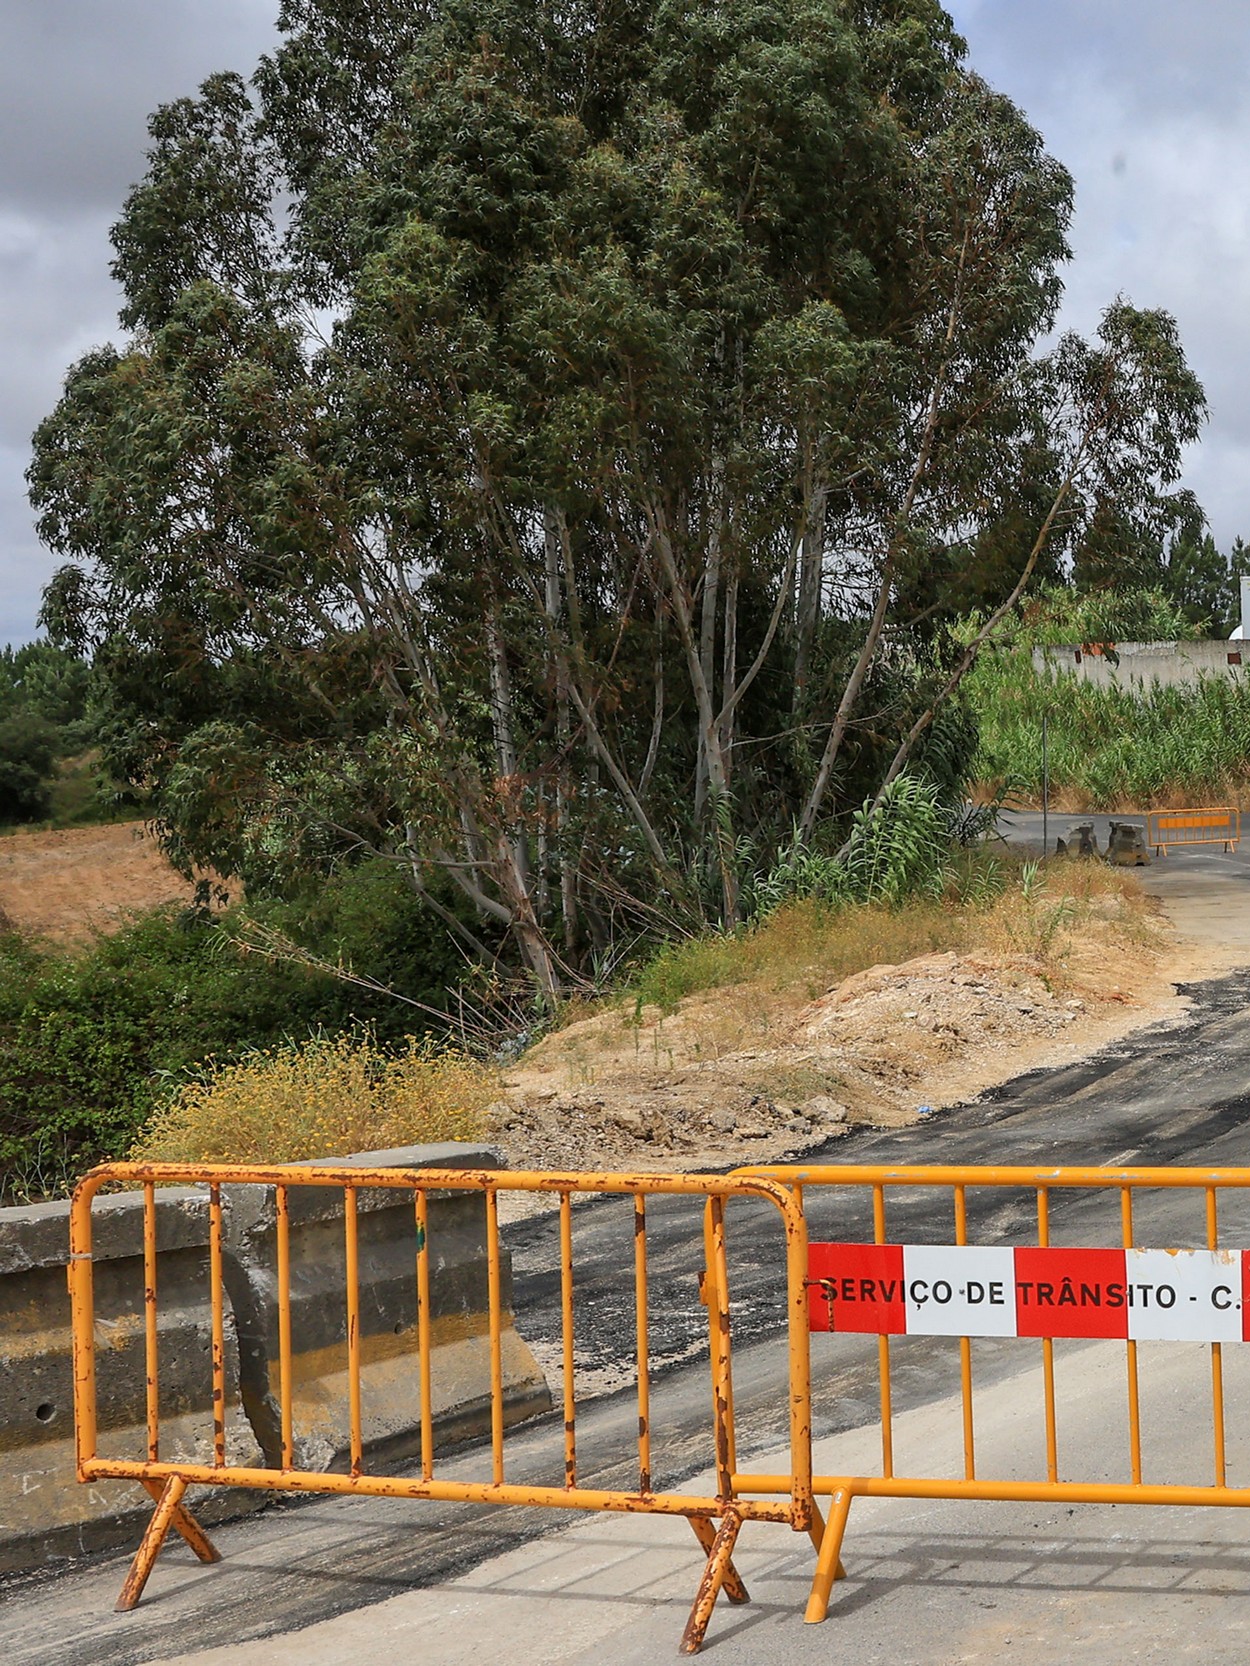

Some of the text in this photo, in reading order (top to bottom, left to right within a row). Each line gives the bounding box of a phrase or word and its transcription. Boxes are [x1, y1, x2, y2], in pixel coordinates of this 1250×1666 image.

[820, 1276, 953, 1311] SERVIÇO
[966, 1281, 1006, 1305] DE
[1017, 1276, 1177, 1308] TRÂNSITO
[1210, 1285, 1241, 1310] C.
